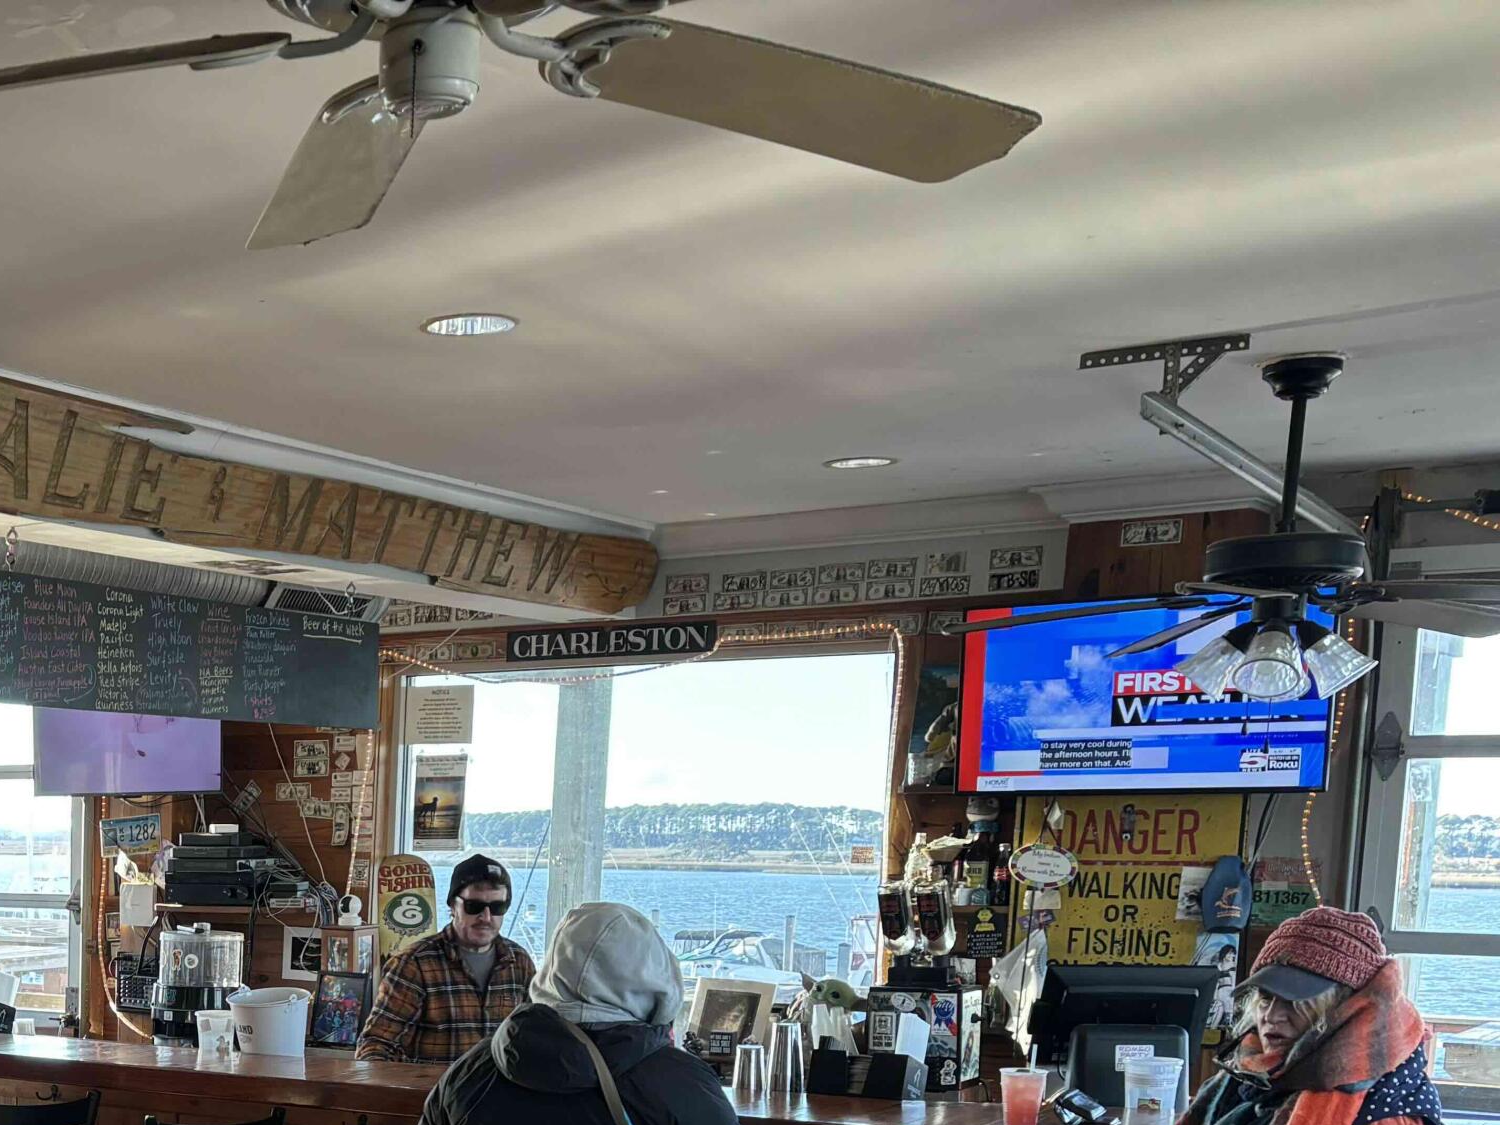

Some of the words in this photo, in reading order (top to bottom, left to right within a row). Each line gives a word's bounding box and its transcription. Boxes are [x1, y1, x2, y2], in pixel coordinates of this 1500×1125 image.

[255, 474, 582, 597] MATTHEW
[34, 579, 53, 596] Blue
[105, 587, 134, 603] Corona
[97, 603, 124, 617] Corona
[125, 604, 144, 623] Light
[150, 596, 176, 613] White
[178, 599, 200, 614] Claw
[0, 608, 20, 627] Light
[302, 615, 320, 631] Beer
[322, 618, 331, 635] of
[513, 625, 709, 659] CHARLESTON
[1041, 741, 1049, 749] to
[1050, 741, 1067, 750] stay
[1068, 742, 1086, 750] very
[1087, 740, 1105, 748] cool
[1106, 739, 1132, 749] during
[1040, 760, 1059, 768] have
[1094, 759, 1113, 767] that.
[1114, 759, 1132, 767] And
[1054, 750, 1093, 759] afternoon
[1094, 750, 1120, 758] hours.
[128, 822, 157, 843] 1282
[1058, 808, 1200, 856] DANGER
[379, 863, 430, 877] GONE
[1067, 871, 1182, 900] WALKING
[1103, 904, 1139, 923] OR
[1067, 927, 1172, 957] FISHING
